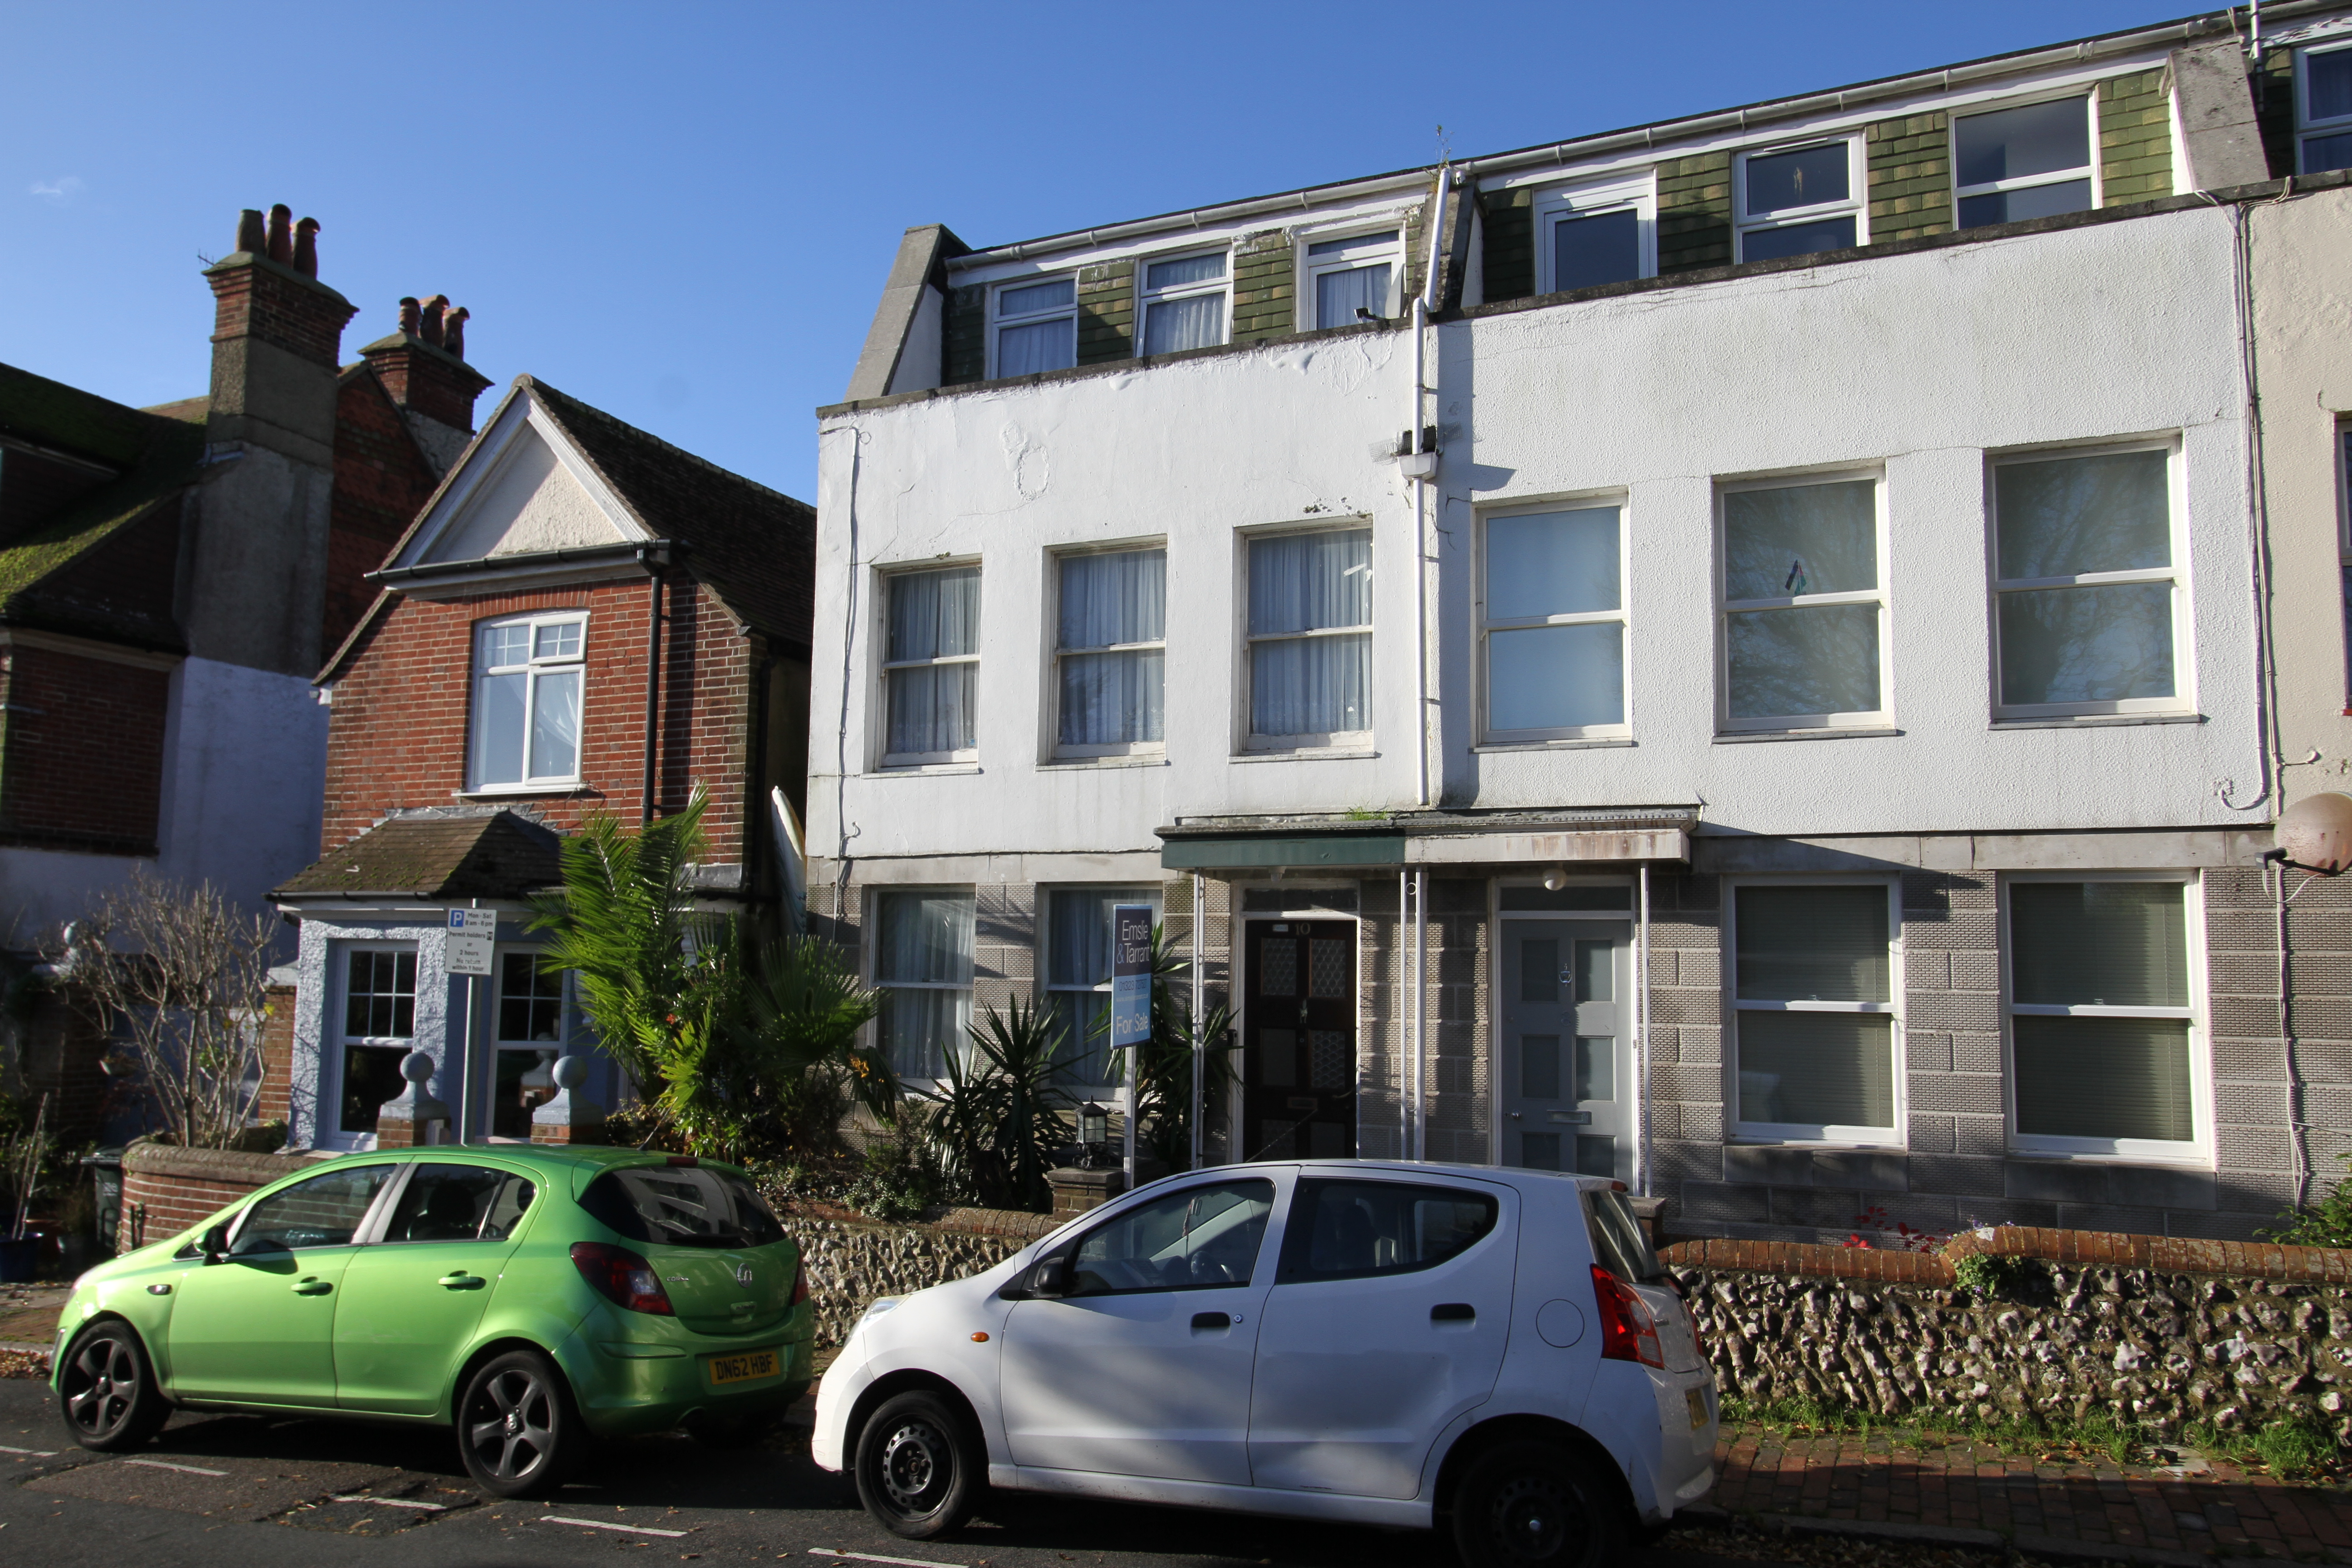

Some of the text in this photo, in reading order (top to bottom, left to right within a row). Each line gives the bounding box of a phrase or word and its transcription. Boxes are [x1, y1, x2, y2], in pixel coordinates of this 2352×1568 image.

[454, 912, 462, 925] P
[1295, 923, 1311, 935] 10
[1122, 920, 1148, 941] Emslie
[1117, 943, 1149, 964] & Tarrant
[1119, 980, 1134, 991] 01323
[1116, 1012, 1148, 1035] For Sale
[715, 1354, 772, 1380] DN62 HBF
